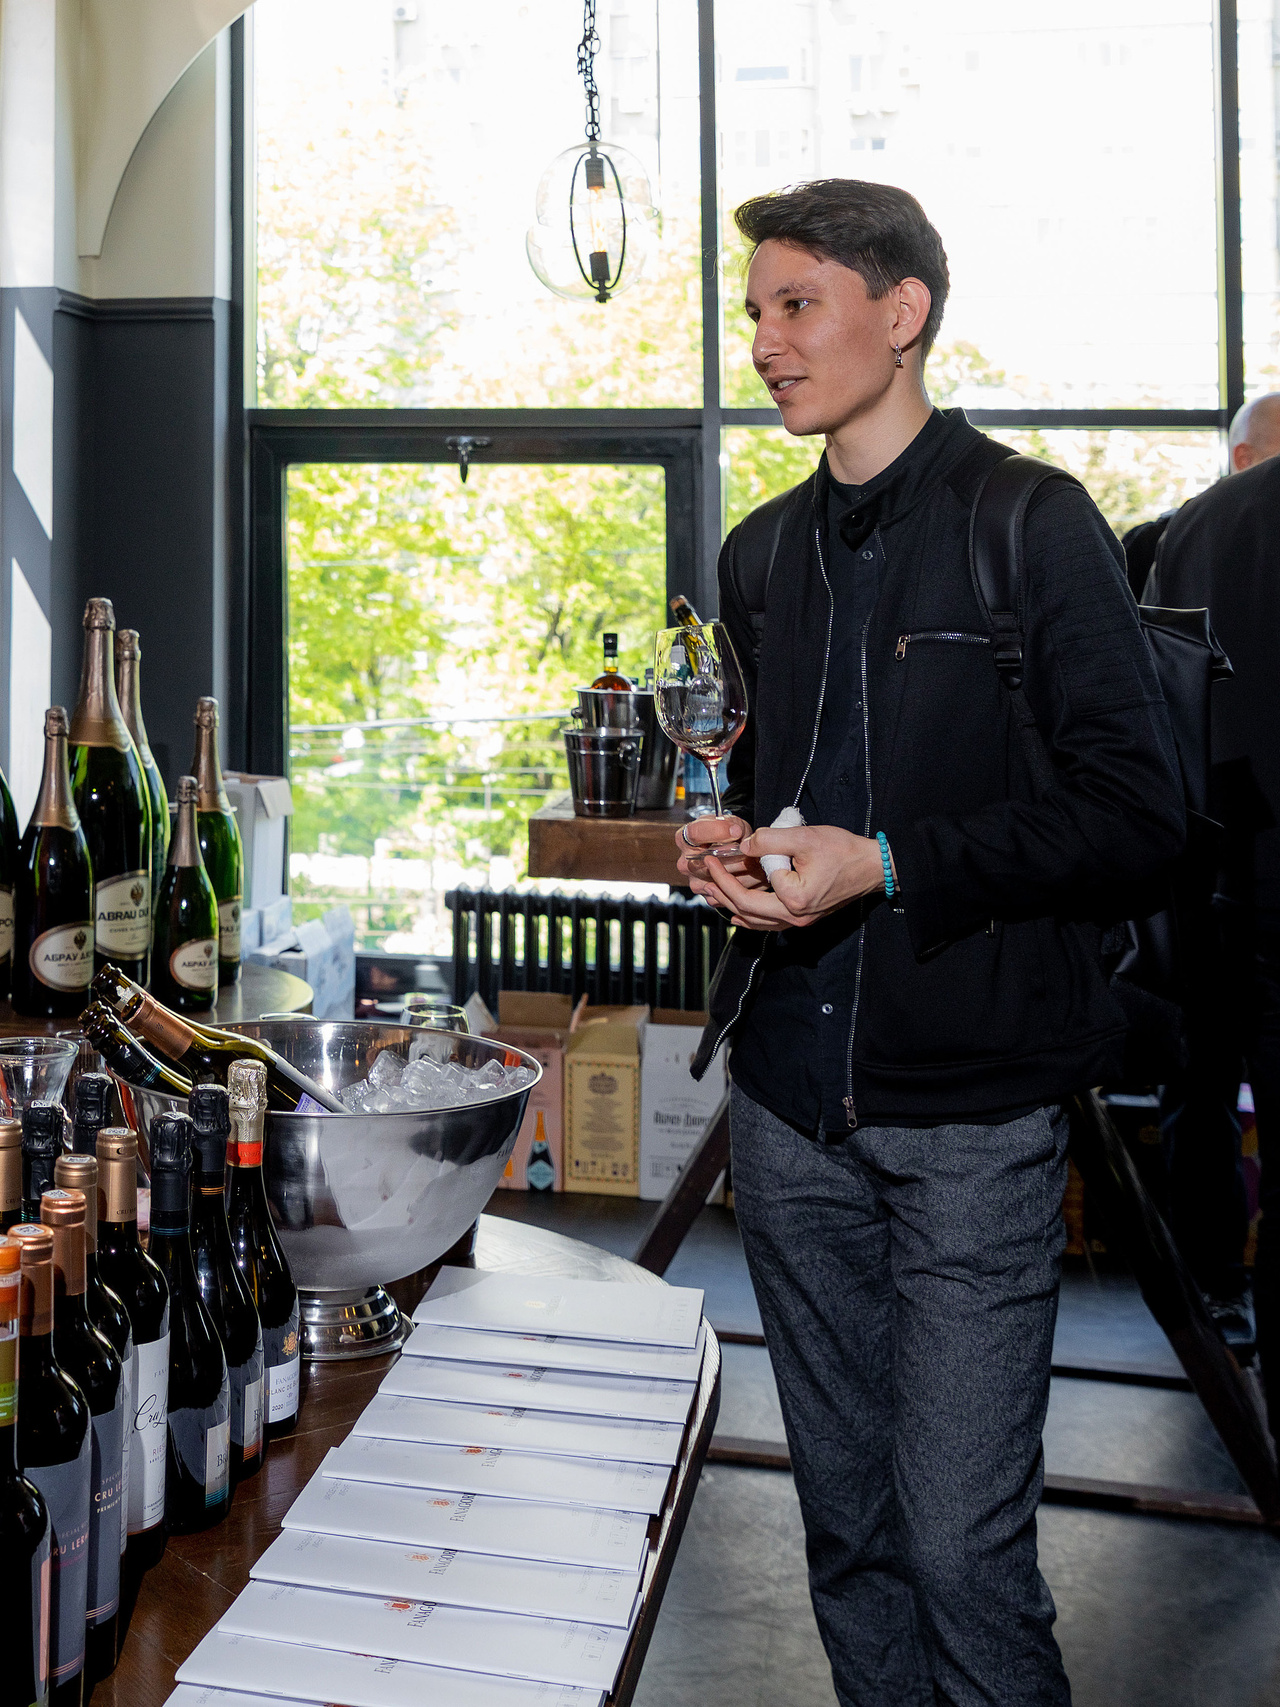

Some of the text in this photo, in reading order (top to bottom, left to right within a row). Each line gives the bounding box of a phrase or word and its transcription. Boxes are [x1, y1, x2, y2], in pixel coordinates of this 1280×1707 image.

[97, 910, 138, 922] ABRAU
[43, 952, 78, 963] АБРАУ
[94, 1487, 114, 1502] CRU
[449, 1492, 477, 1523] FANAGOR
[428, 1548, 458, 1576] FANAGOR
